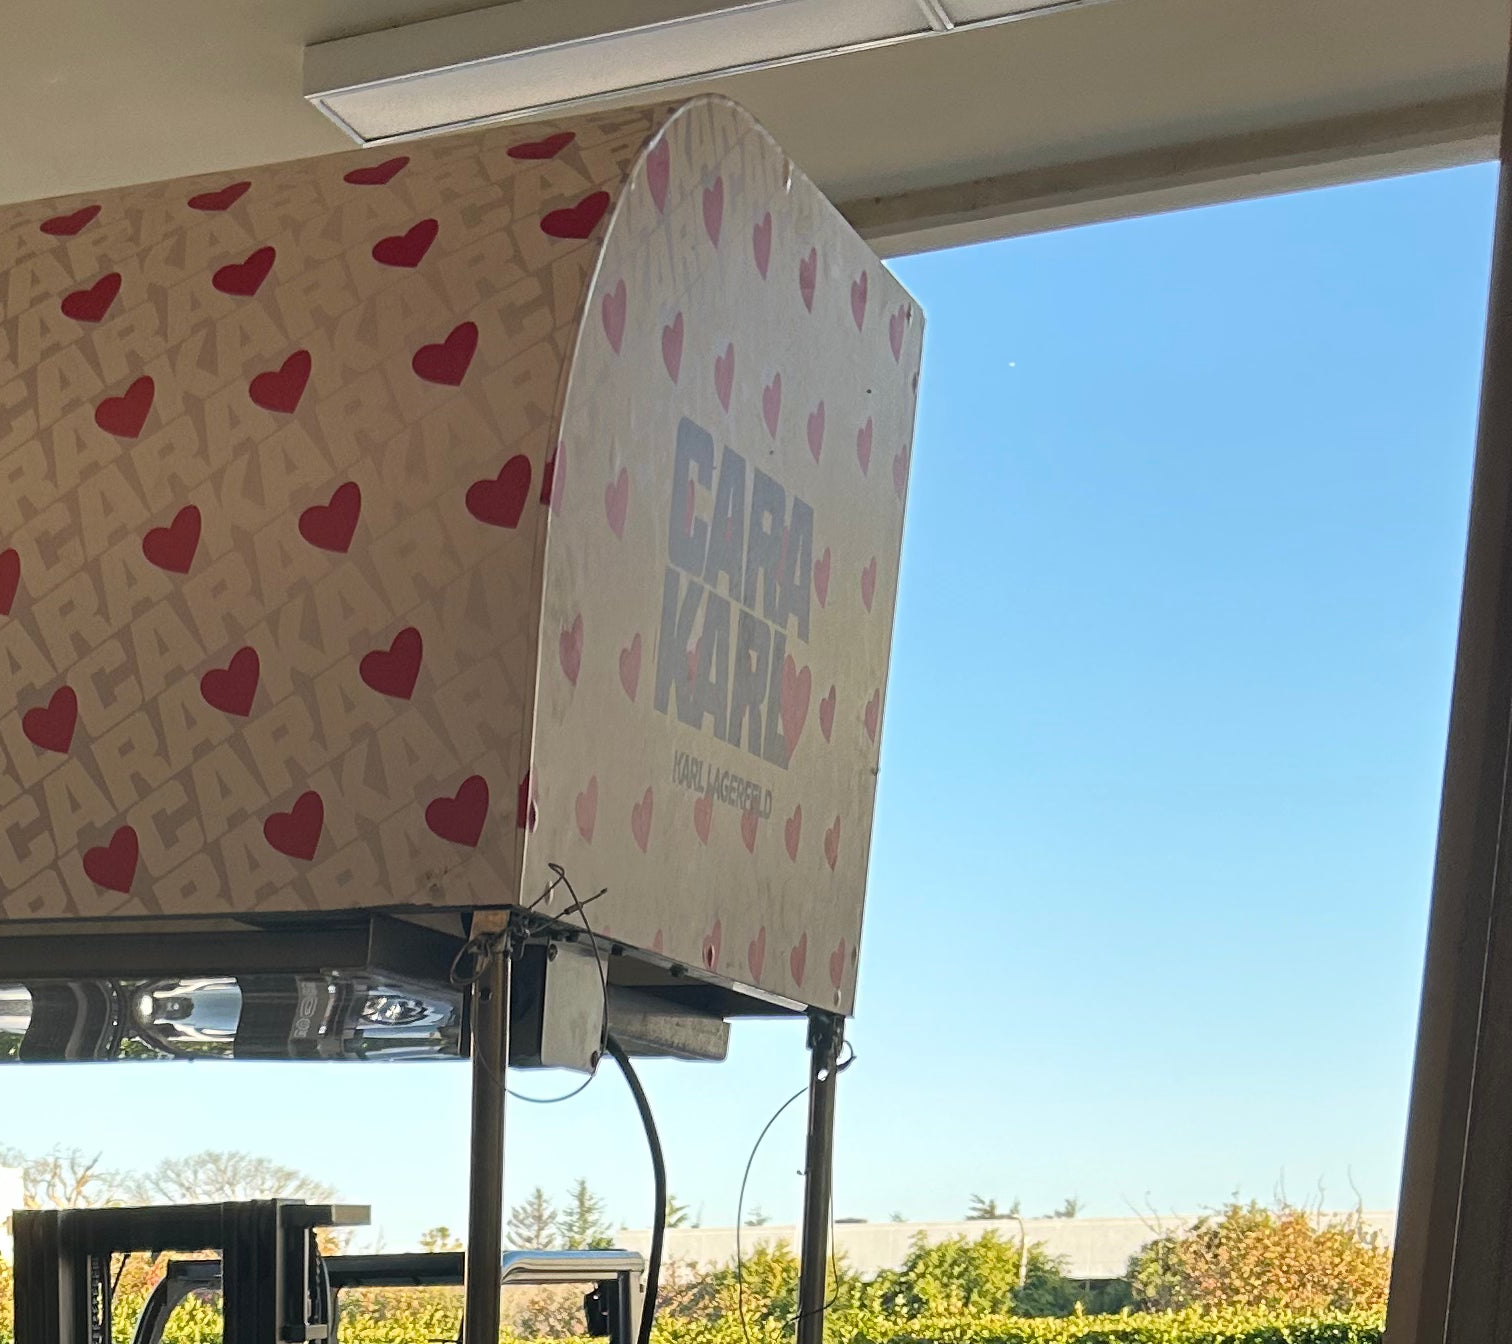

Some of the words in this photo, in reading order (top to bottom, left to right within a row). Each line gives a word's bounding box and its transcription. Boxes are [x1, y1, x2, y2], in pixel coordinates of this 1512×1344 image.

[668, 416, 814, 645] CARA
[653, 565, 789, 770] KARL
[673, 750, 705, 794] KARL
[705, 766, 773, 820] LAGERFELD
